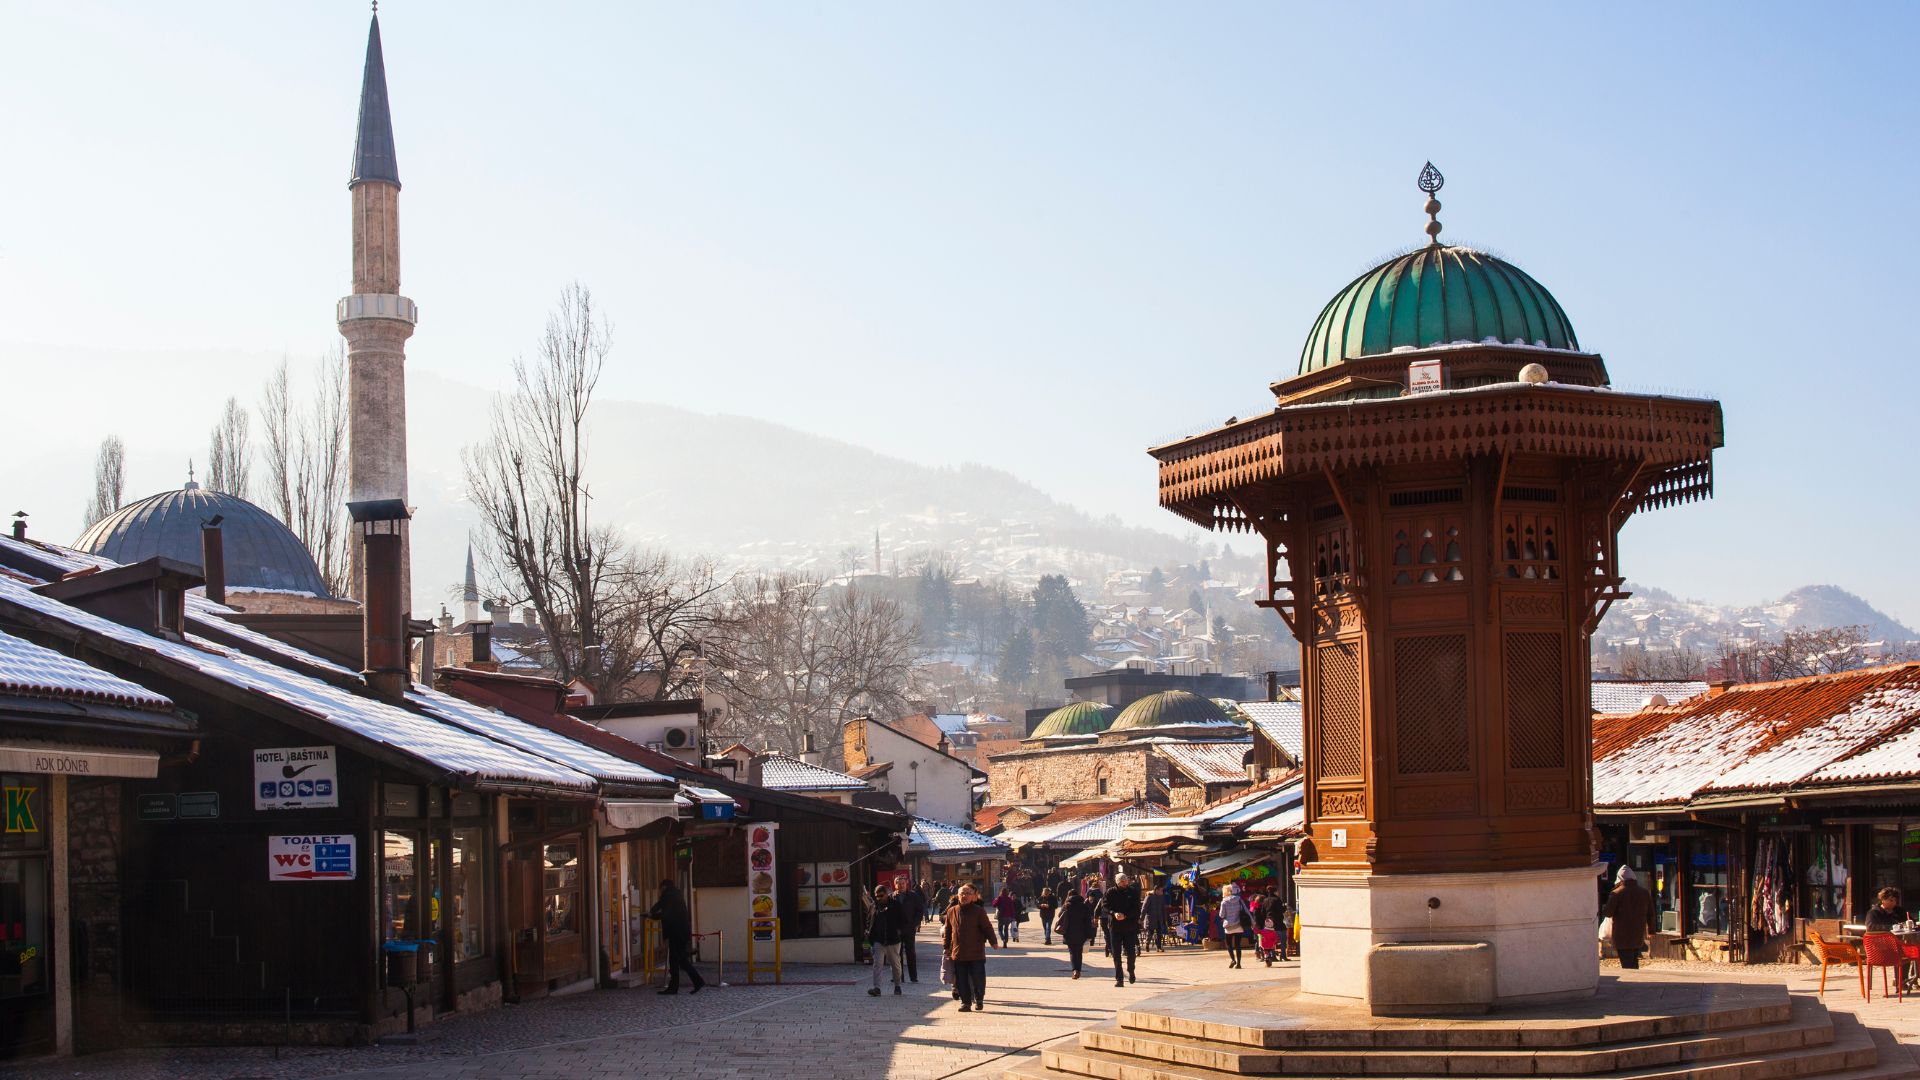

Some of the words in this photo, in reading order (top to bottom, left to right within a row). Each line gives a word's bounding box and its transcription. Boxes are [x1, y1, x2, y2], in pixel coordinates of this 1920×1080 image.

[256, 752, 284, 762] HOTEL
[291, 749, 328, 761] BAŠTINA
[35, 757, 55, 771] ADK
[57, 756, 90, 773] DÖNER
[282, 836, 341, 845] TOALET
[273, 854, 311, 867] WC
